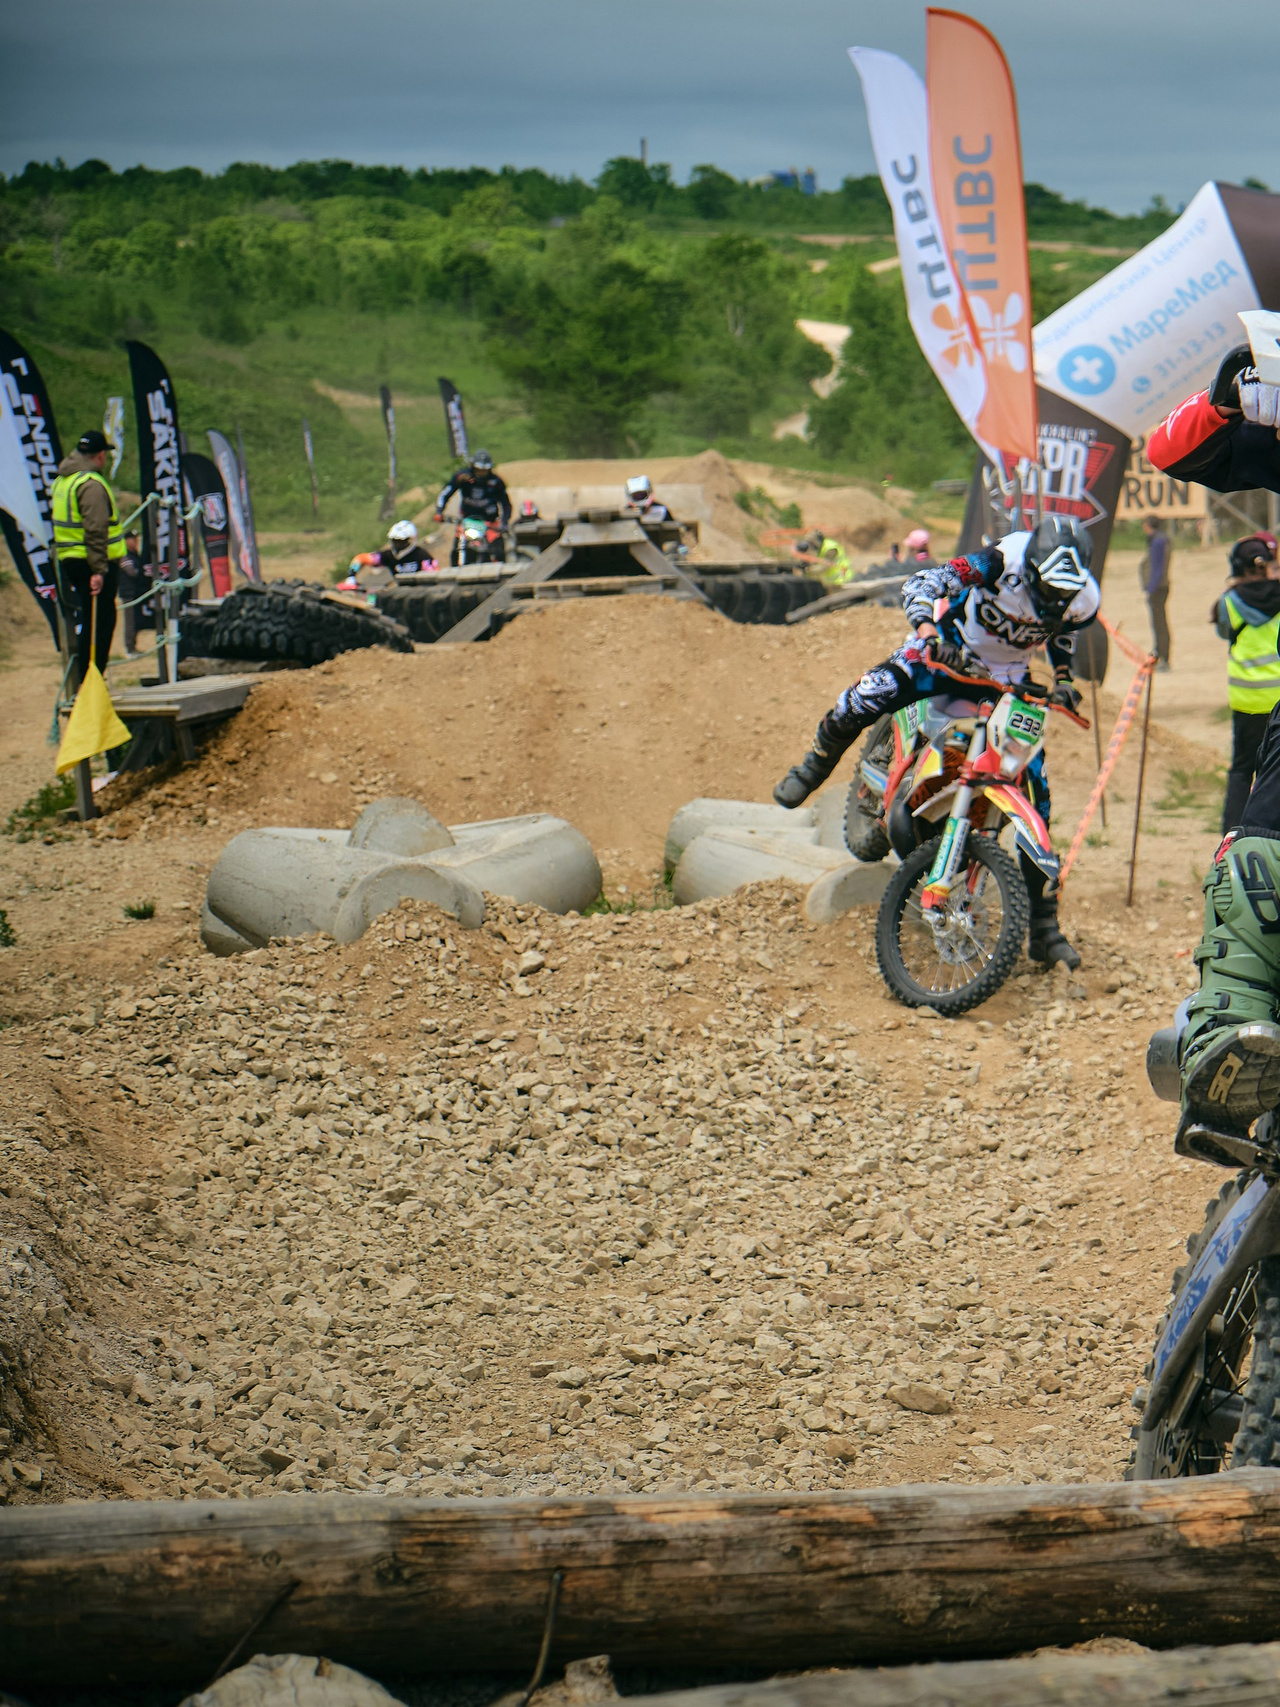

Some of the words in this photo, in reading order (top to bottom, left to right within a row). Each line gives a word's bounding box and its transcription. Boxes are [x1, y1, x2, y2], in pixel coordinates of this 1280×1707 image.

[1109, 259, 1239, 355] МареМед
[1124, 477, 1190, 508] RUN
[1009, 711, 1042, 737] 292
